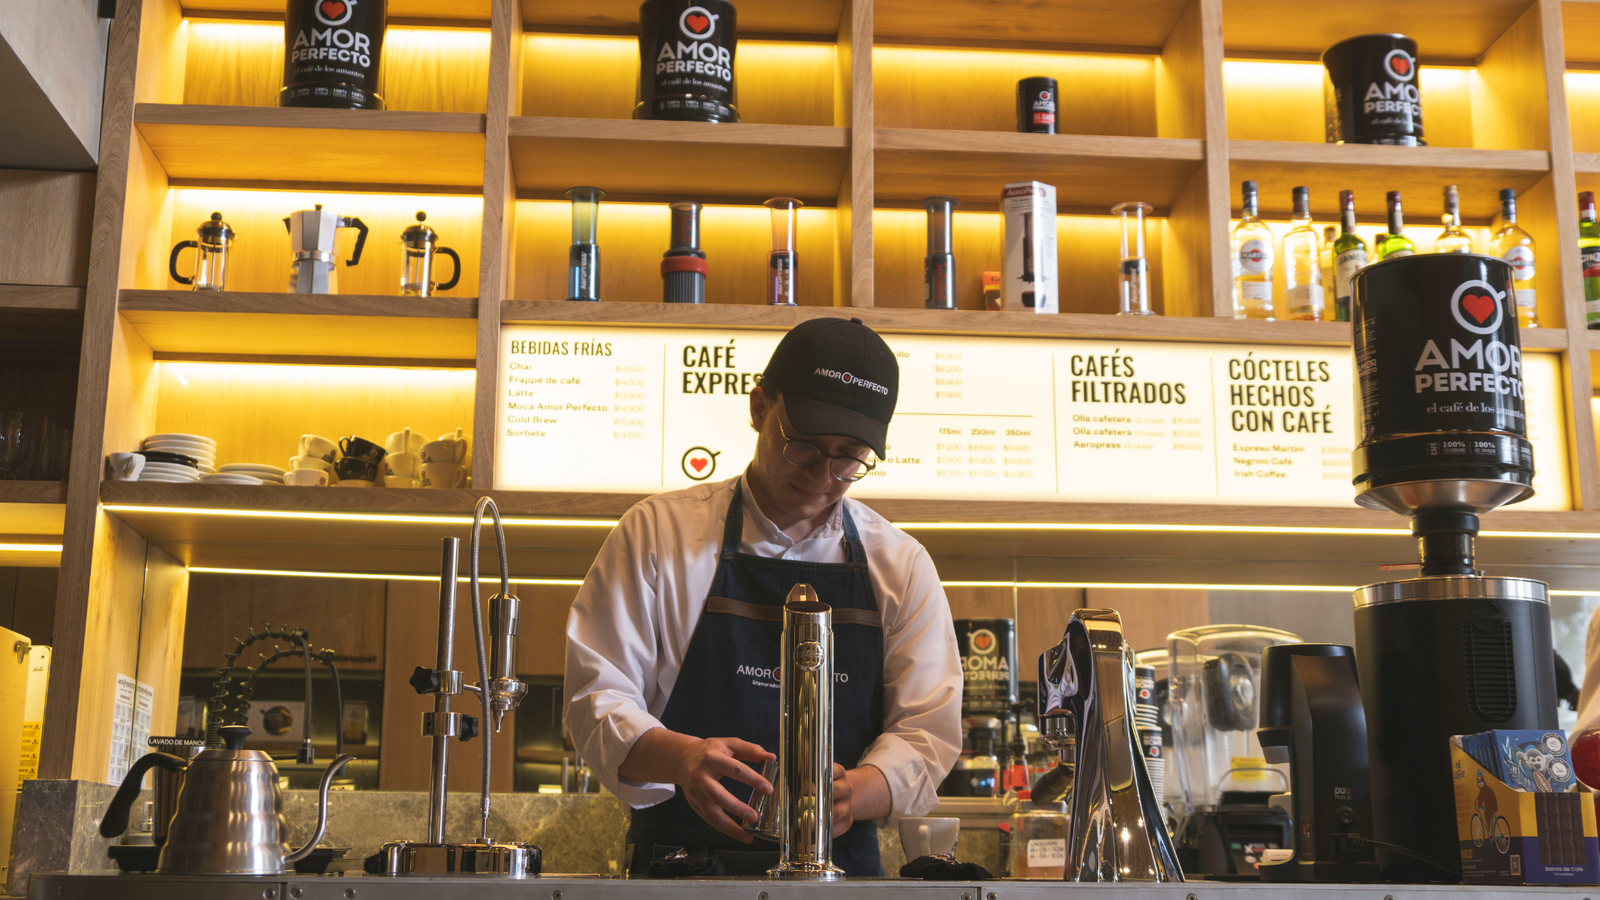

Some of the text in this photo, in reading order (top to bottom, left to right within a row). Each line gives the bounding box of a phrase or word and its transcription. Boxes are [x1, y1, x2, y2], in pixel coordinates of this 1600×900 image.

[293, 27, 370, 55] AMOR
[291, 47, 371, 68] PERFECTO
[657, 40, 731, 69] AMOR
[335, 67, 365, 79] amantes
[656, 60, 732, 82] PERFECTO
[692, 78, 702, 86] los
[1364, 81, 1421, 103] AMO
[510, 338, 613, 356] BEBIDAS FRÍAS
[682, 339, 736, 369] CAFÉ
[1070, 348, 1136, 378] CAFÉS
[1415, 338, 1522, 378] AMOR
[510, 362, 532, 371] Chai
[1228, 352, 1331, 382] CÓCTELES
[508, 375, 543, 385] Frappé
[545, 376, 558, 384] de
[560, 376, 580, 385] café
[814, 367, 888, 395] AMOR PERFECTO
[1415, 372, 1524, 400] PERFECTO
[508, 388, 534, 398] Latte
[1070, 380, 1187, 405] FILTRADOS
[1230, 384, 1315, 408] HECHOS
[508, 402, 535, 411] Moca
[537, 403, 564, 412] Amor
[566, 403, 608, 412] Perfecto
[1426, 402, 1438, 414] el
[1440, 402, 1464, 413] café
[1466, 402, 1480, 412] de
[1481, 402, 1496, 413] los
[507, 415, 531, 424] Cold
[532, 416, 558, 424] Brew
[1072, 414, 1091, 422] Olla
[1093, 415, 1132, 424] cafetera
[1231, 405, 1334, 434] CON CAFÉ
[506, 428, 546, 438] Sorbete
[1072, 427, 1091, 436] Olla
[1094, 428, 1132, 436] cafetera
[1073, 440, 1122, 450] Aeropress
[896, 456, 921, 464] Latte
[736, 664, 772, 679] AMOR
[148, 738, 174, 746] LAVADO
